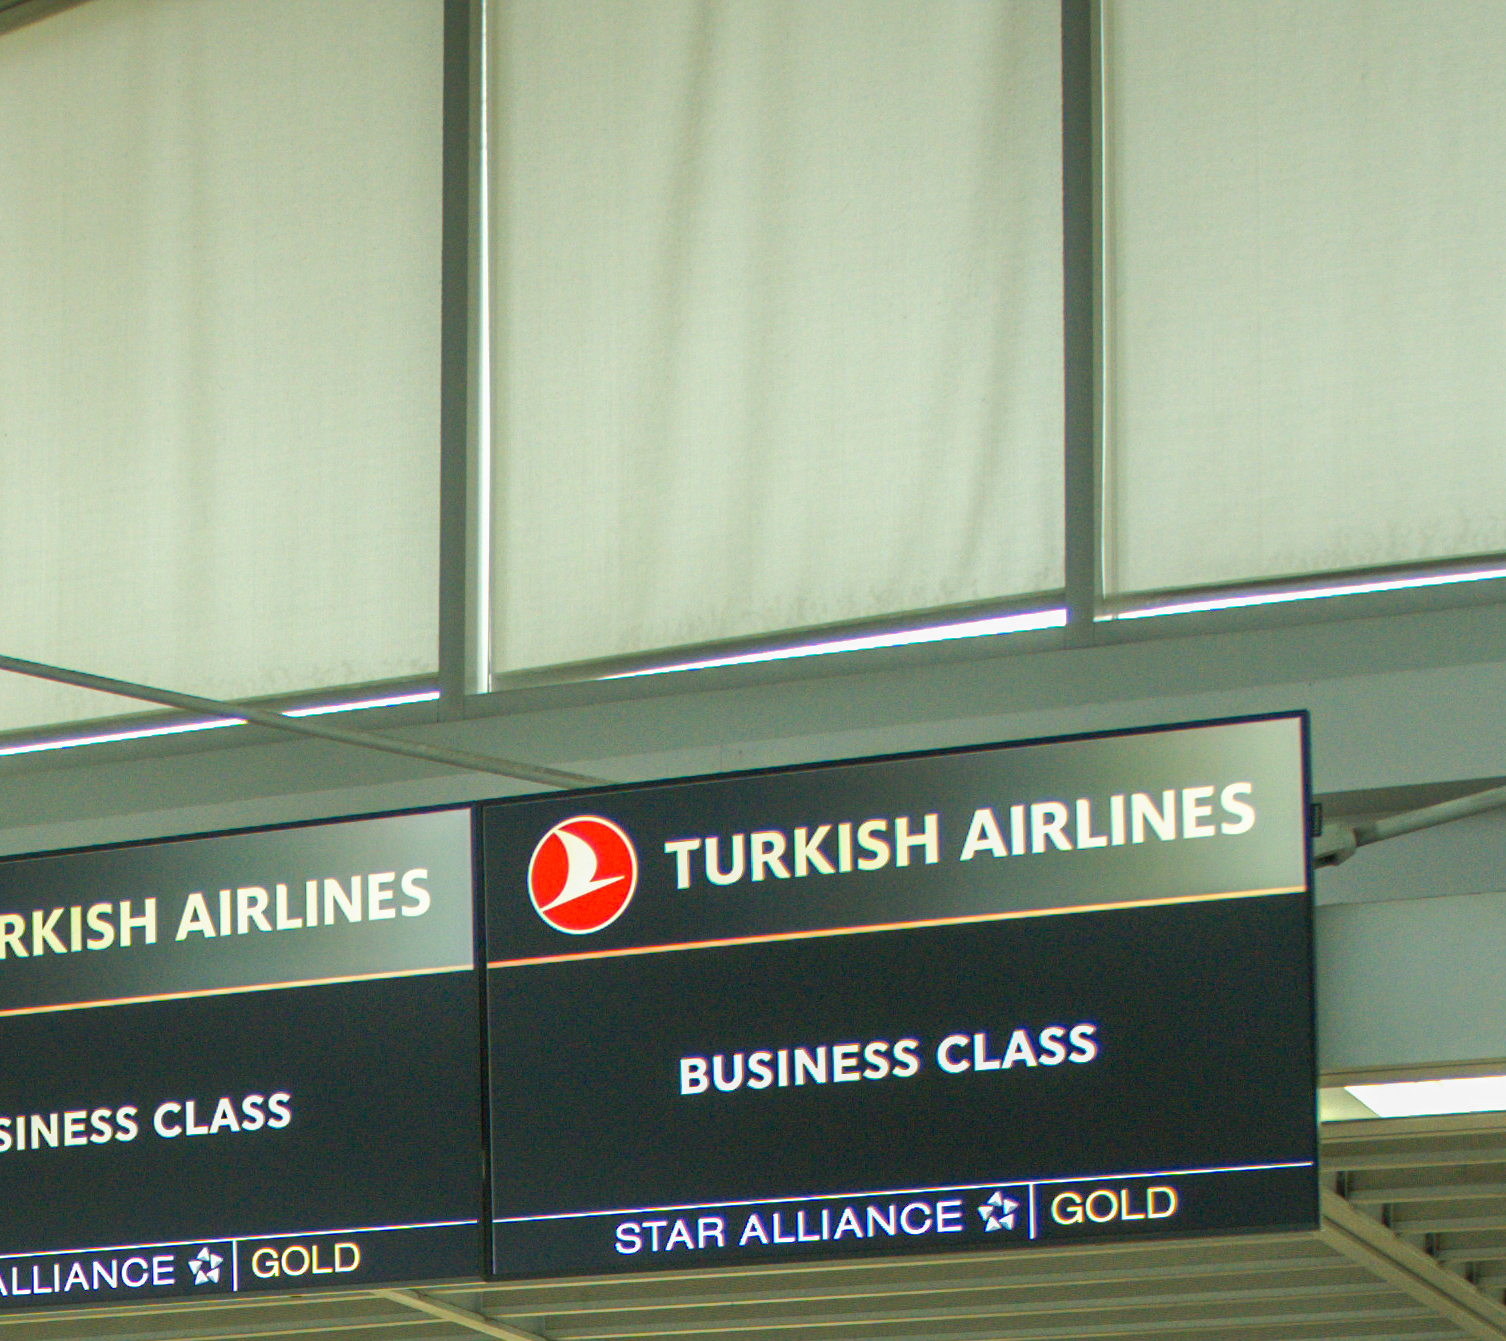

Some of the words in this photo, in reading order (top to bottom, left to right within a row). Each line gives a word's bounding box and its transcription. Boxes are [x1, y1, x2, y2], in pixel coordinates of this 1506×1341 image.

[665, 813, 940, 890] TURKISH
[960, 782, 1257, 862] AIRLINES
[176, 868, 432, 942] AIRLINES
[679, 1039, 919, 1096] BUSINESS
[936, 1024, 1099, 1075] CLASS
[152, 1092, 292, 1140] CLASS
[614, 1219, 725, 1255] STAR
[739, 1200, 963, 1247] ALLIANCE
[1051, 1185, 1178, 1226] GOLD
[251, 1242, 361, 1278] GOLD
